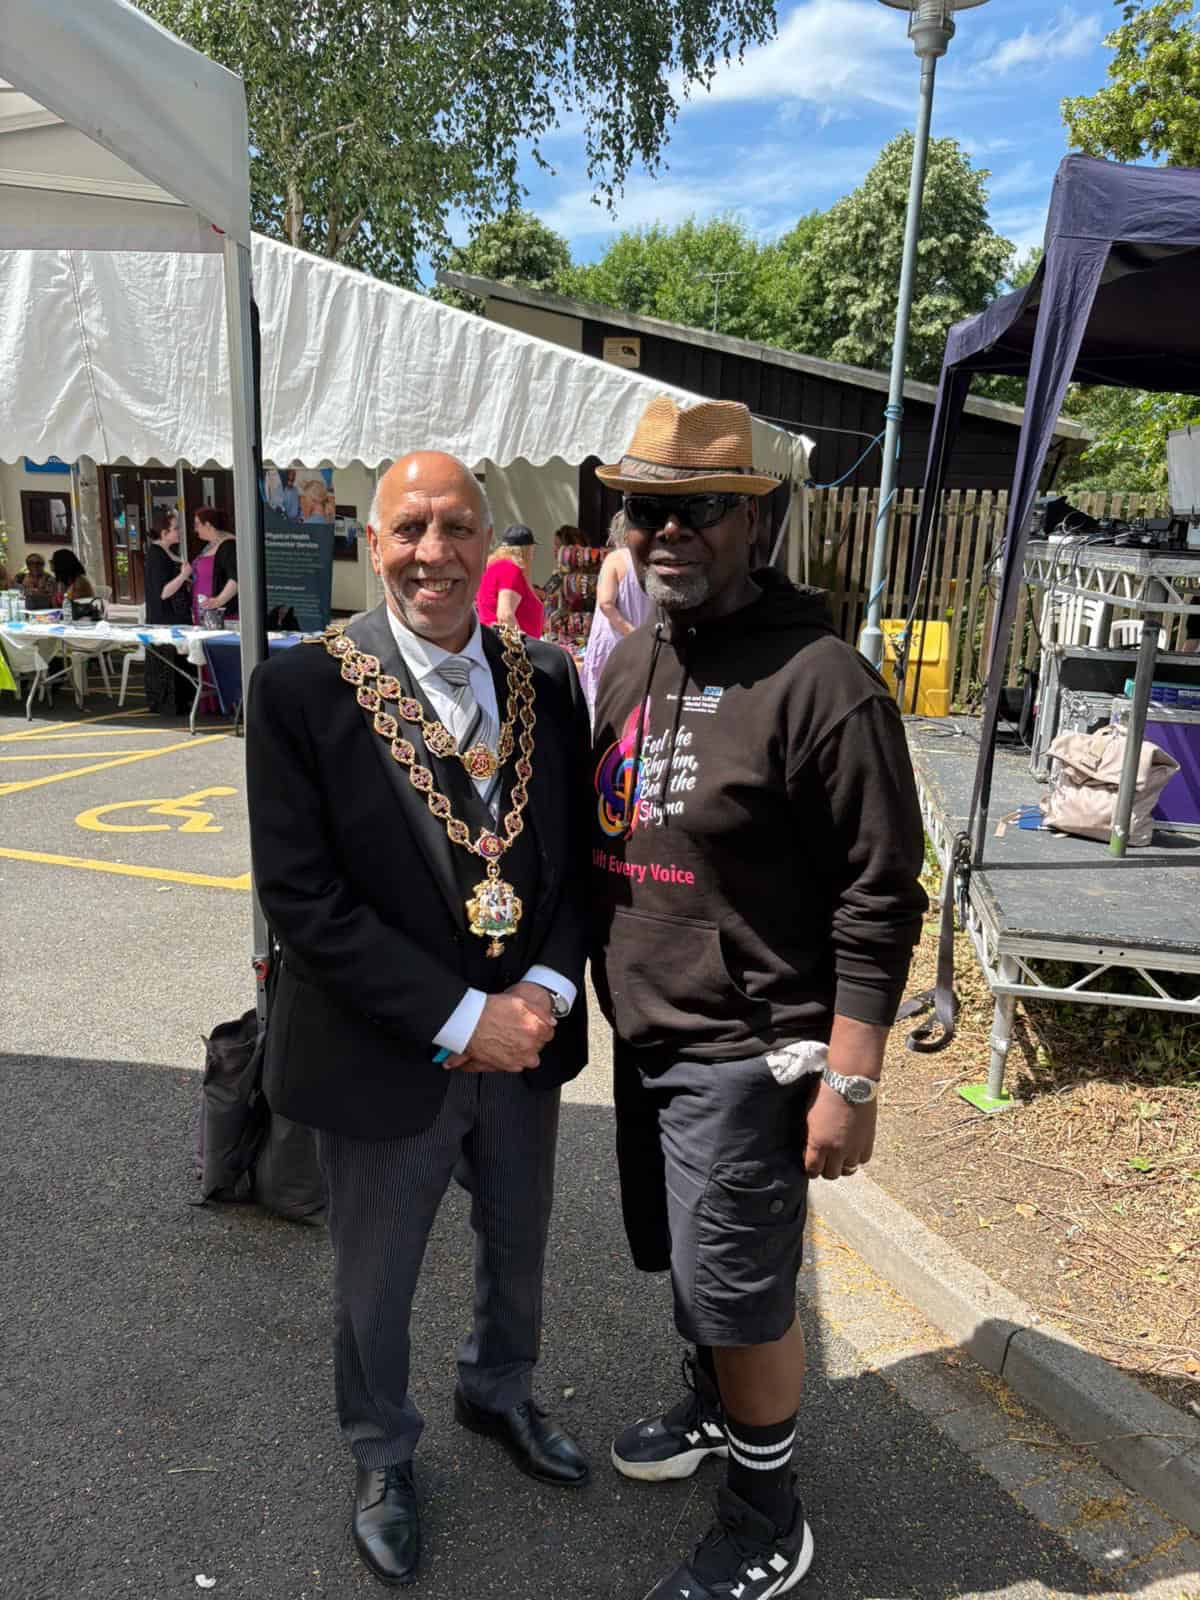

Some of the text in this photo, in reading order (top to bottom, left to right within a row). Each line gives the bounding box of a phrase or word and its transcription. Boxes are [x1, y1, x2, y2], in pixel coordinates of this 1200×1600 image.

[641, 728, 670, 756] Feel
[640, 748, 698, 781] Rhyhm,
[640, 768, 697, 799] Bea the
[608, 855, 647, 884] Every
[650, 863, 695, 885] Voice
